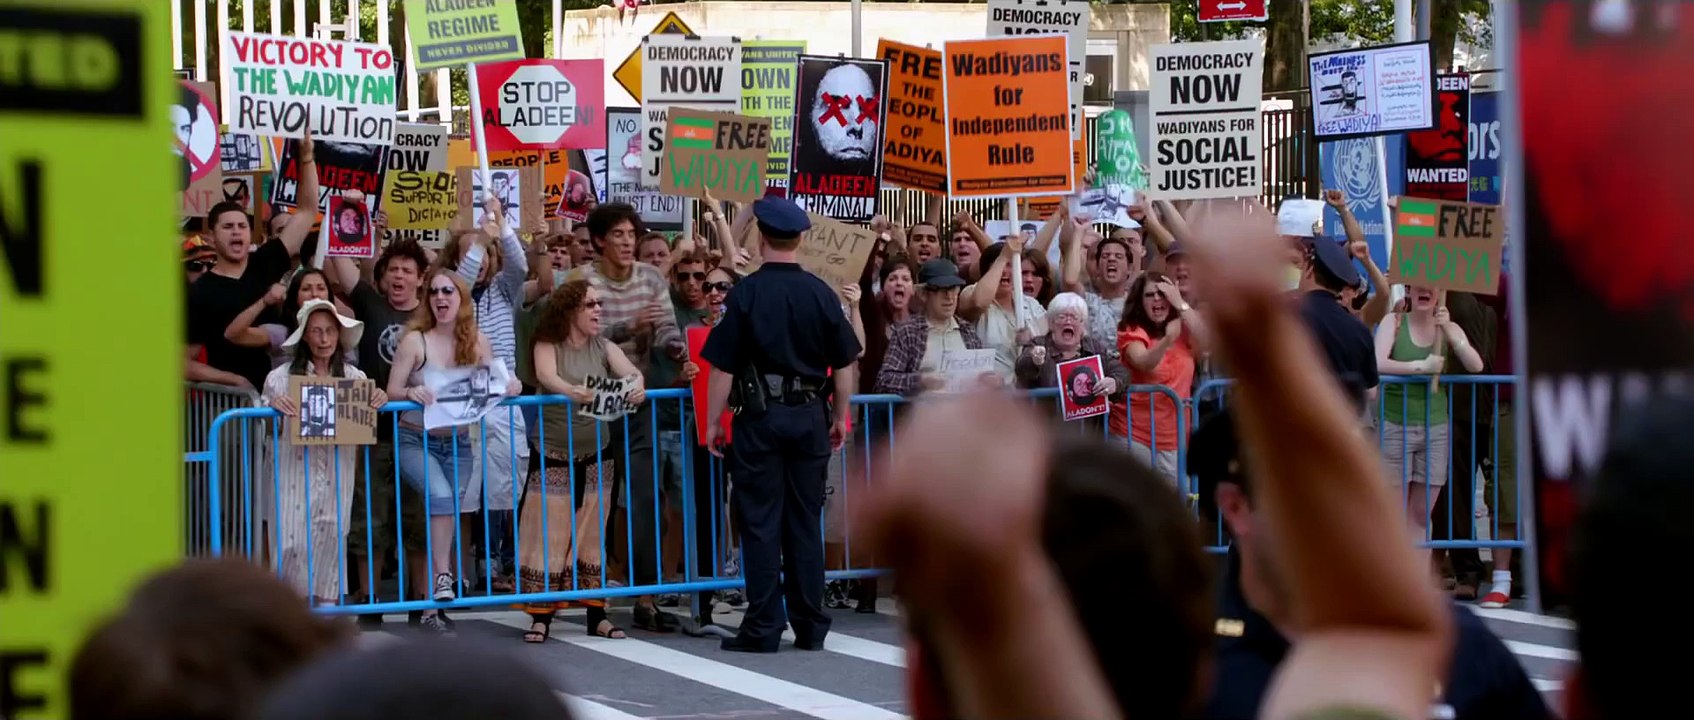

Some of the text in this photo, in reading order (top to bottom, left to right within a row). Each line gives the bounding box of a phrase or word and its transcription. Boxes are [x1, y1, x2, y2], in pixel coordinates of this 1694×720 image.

[427, 14, 500, 38] REGIME
[993, 8, 1080, 25] DEMOCRACY
[231, 36, 392, 69] VICTORY TO
[648, 46, 734, 61] DEMOCRACY
[1156, 53, 1253, 71] DEMOCRACY
[953, 52, 1061, 77] Wadiyans
[233, 67, 394, 105] THE WADIYAN
[661, 66, 723, 94] NOW
[902, 82, 935, 101] THE
[1170, 73, 1242, 104] NOW
[503, 81, 571, 104] STOP
[766, 96, 791, 109] THE
[994, 85, 1024, 106] for
[483, 104, 594, 128] ALADEEN!
[616, 118, 637, 133] NO
[953, 113, 1066, 136] Independent
[1157, 119, 1255, 135] WADIYANS FOR
[396, 133, 441, 147] CRACY
[715, 120, 768, 150] FREE
[901, 125, 924, 139] OF
[988, 143, 1034, 166] Rule
[1157, 136, 1255, 165] SOCIAL
[668, 150, 761, 195] WADIYA
[1158, 166, 1256, 191] JUSTICE!
[1407, 168, 1467, 183] WANTED
[610, 183, 632, 192] THE
[795, 174, 876, 196] ALADEEN
[408, 206, 457, 223] DICTATO
[1438, 204, 1495, 238] FREE
[1397, 240, 1490, 288] WADIYA
